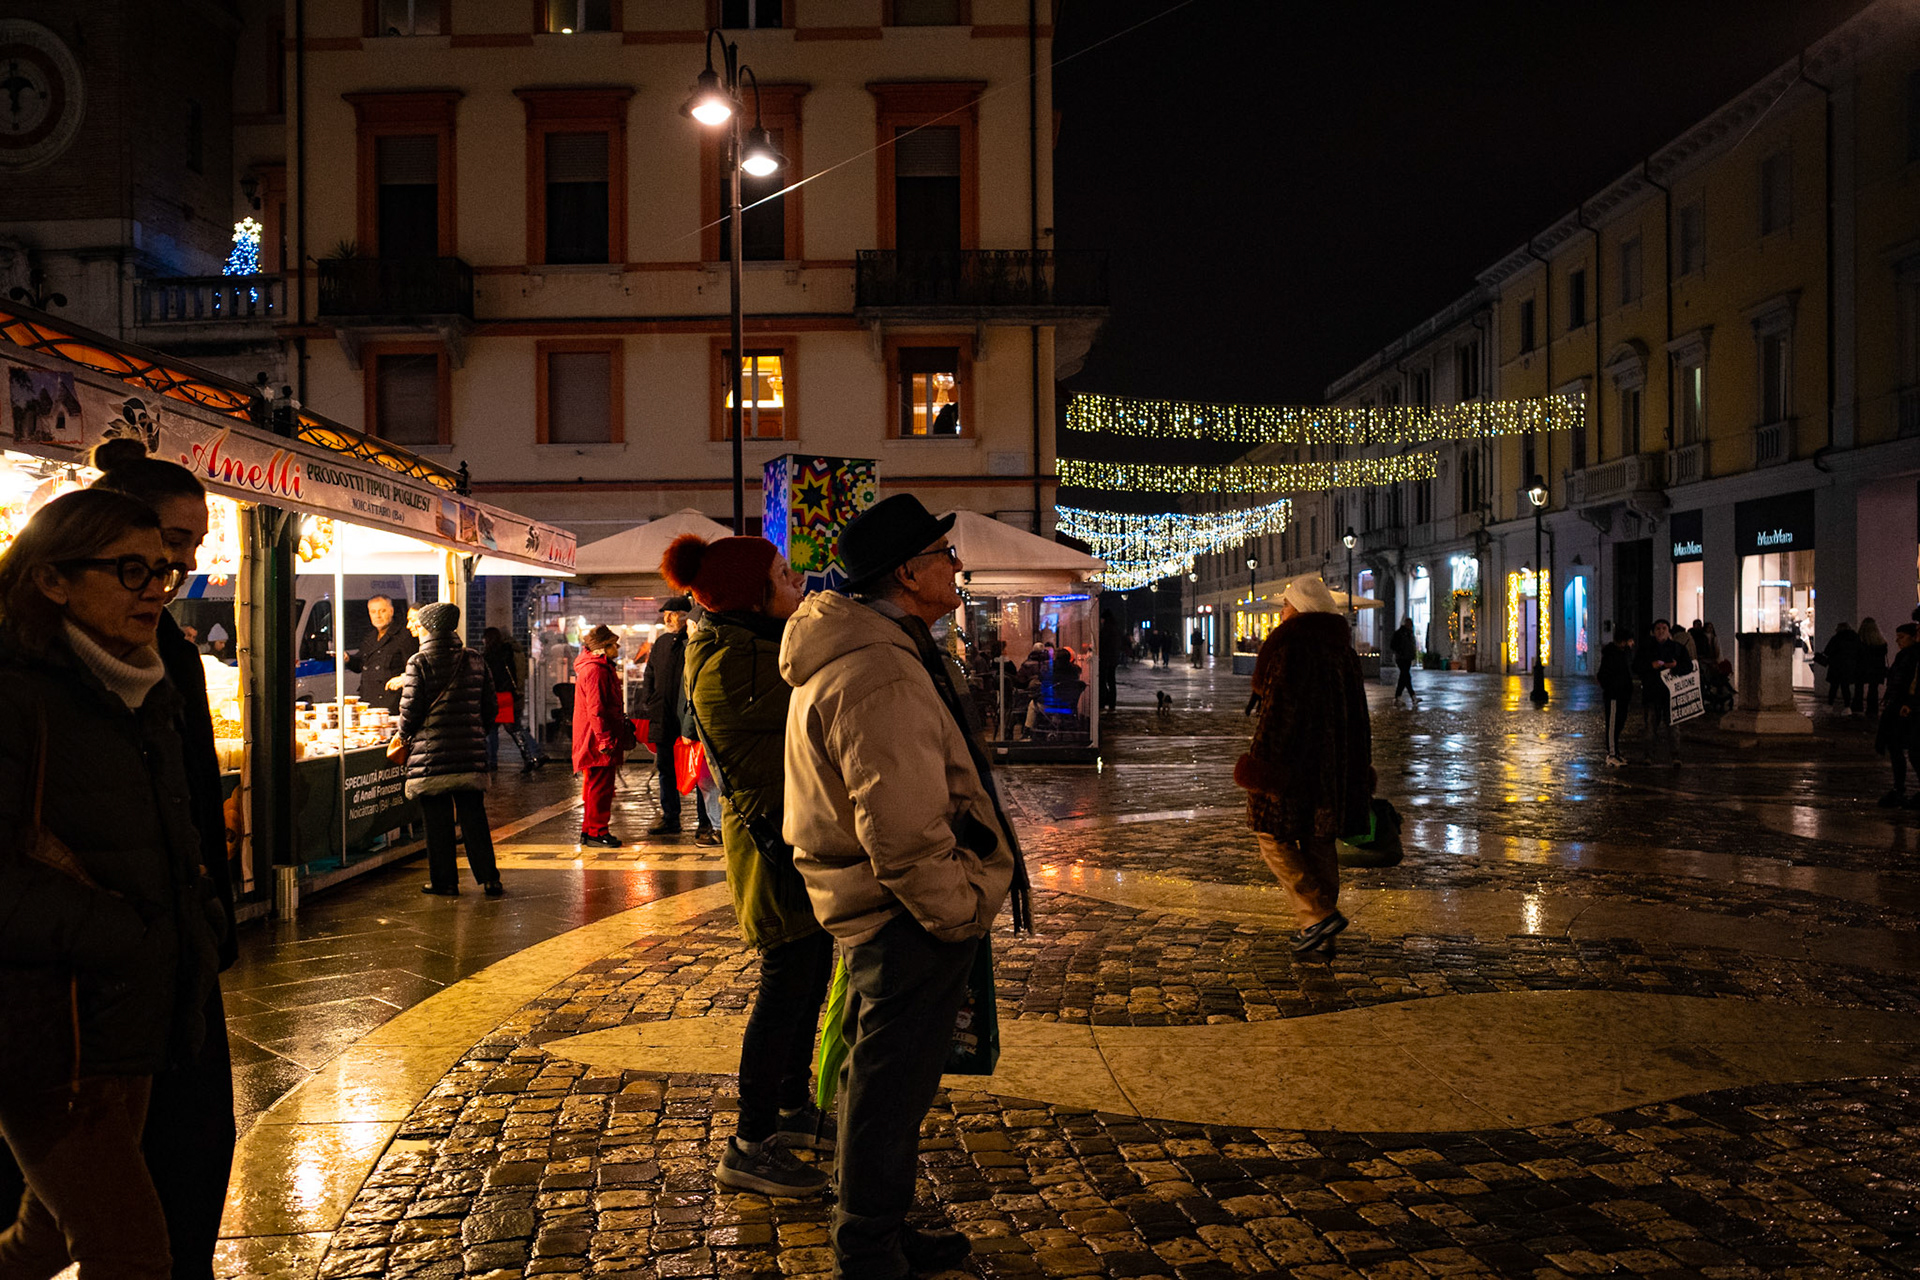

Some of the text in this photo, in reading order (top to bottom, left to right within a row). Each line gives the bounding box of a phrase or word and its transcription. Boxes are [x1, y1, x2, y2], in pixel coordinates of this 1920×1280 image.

[191, 426, 304, 499] Anelli
[306, 463, 431, 512] PRODOTTI TIPICI PUGLIESI
[344, 769, 377, 790] SPECIALITÀ
[378, 766, 399, 781] PUGLIESI
